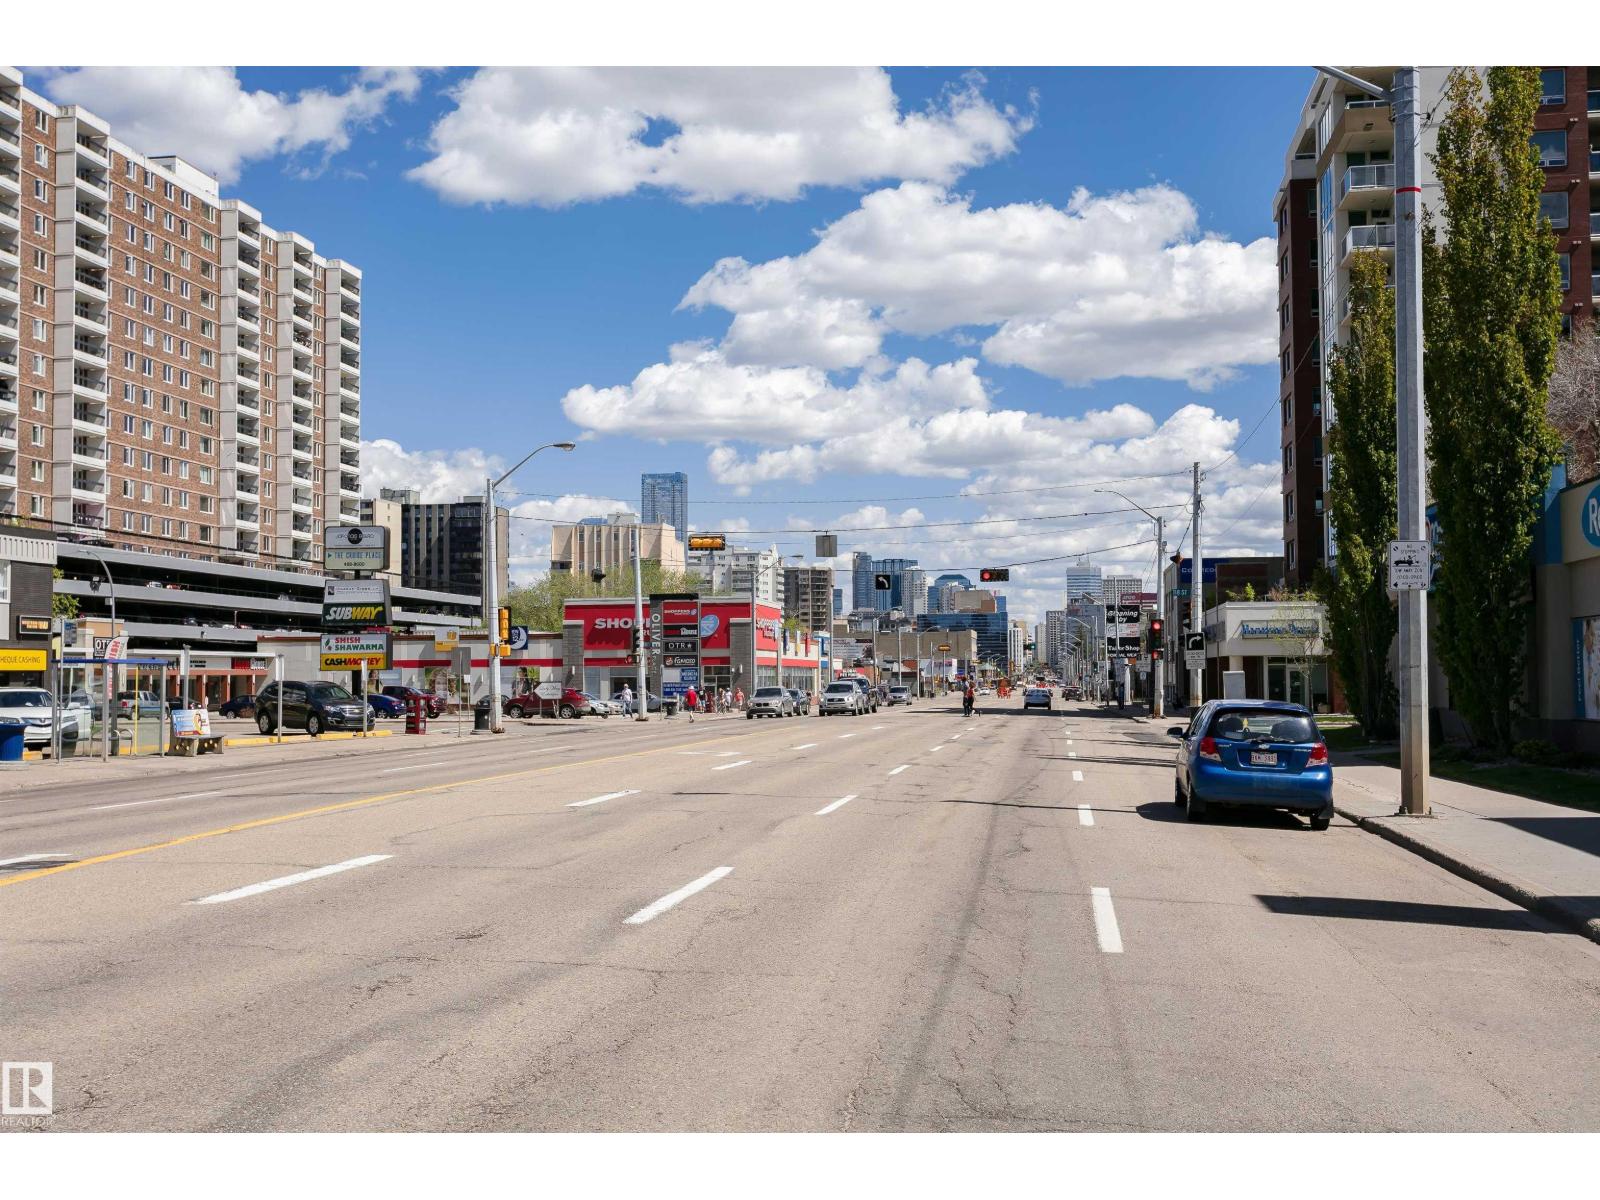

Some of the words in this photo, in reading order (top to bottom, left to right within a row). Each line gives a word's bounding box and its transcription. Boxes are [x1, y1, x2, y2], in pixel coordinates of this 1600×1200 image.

[325, 606, 384, 620] SUBWAY
[651, 613, 661, 655] OLIVER
[335, 643, 384, 651] SHAWARMA
[19, 655, 41, 664] CASHING
